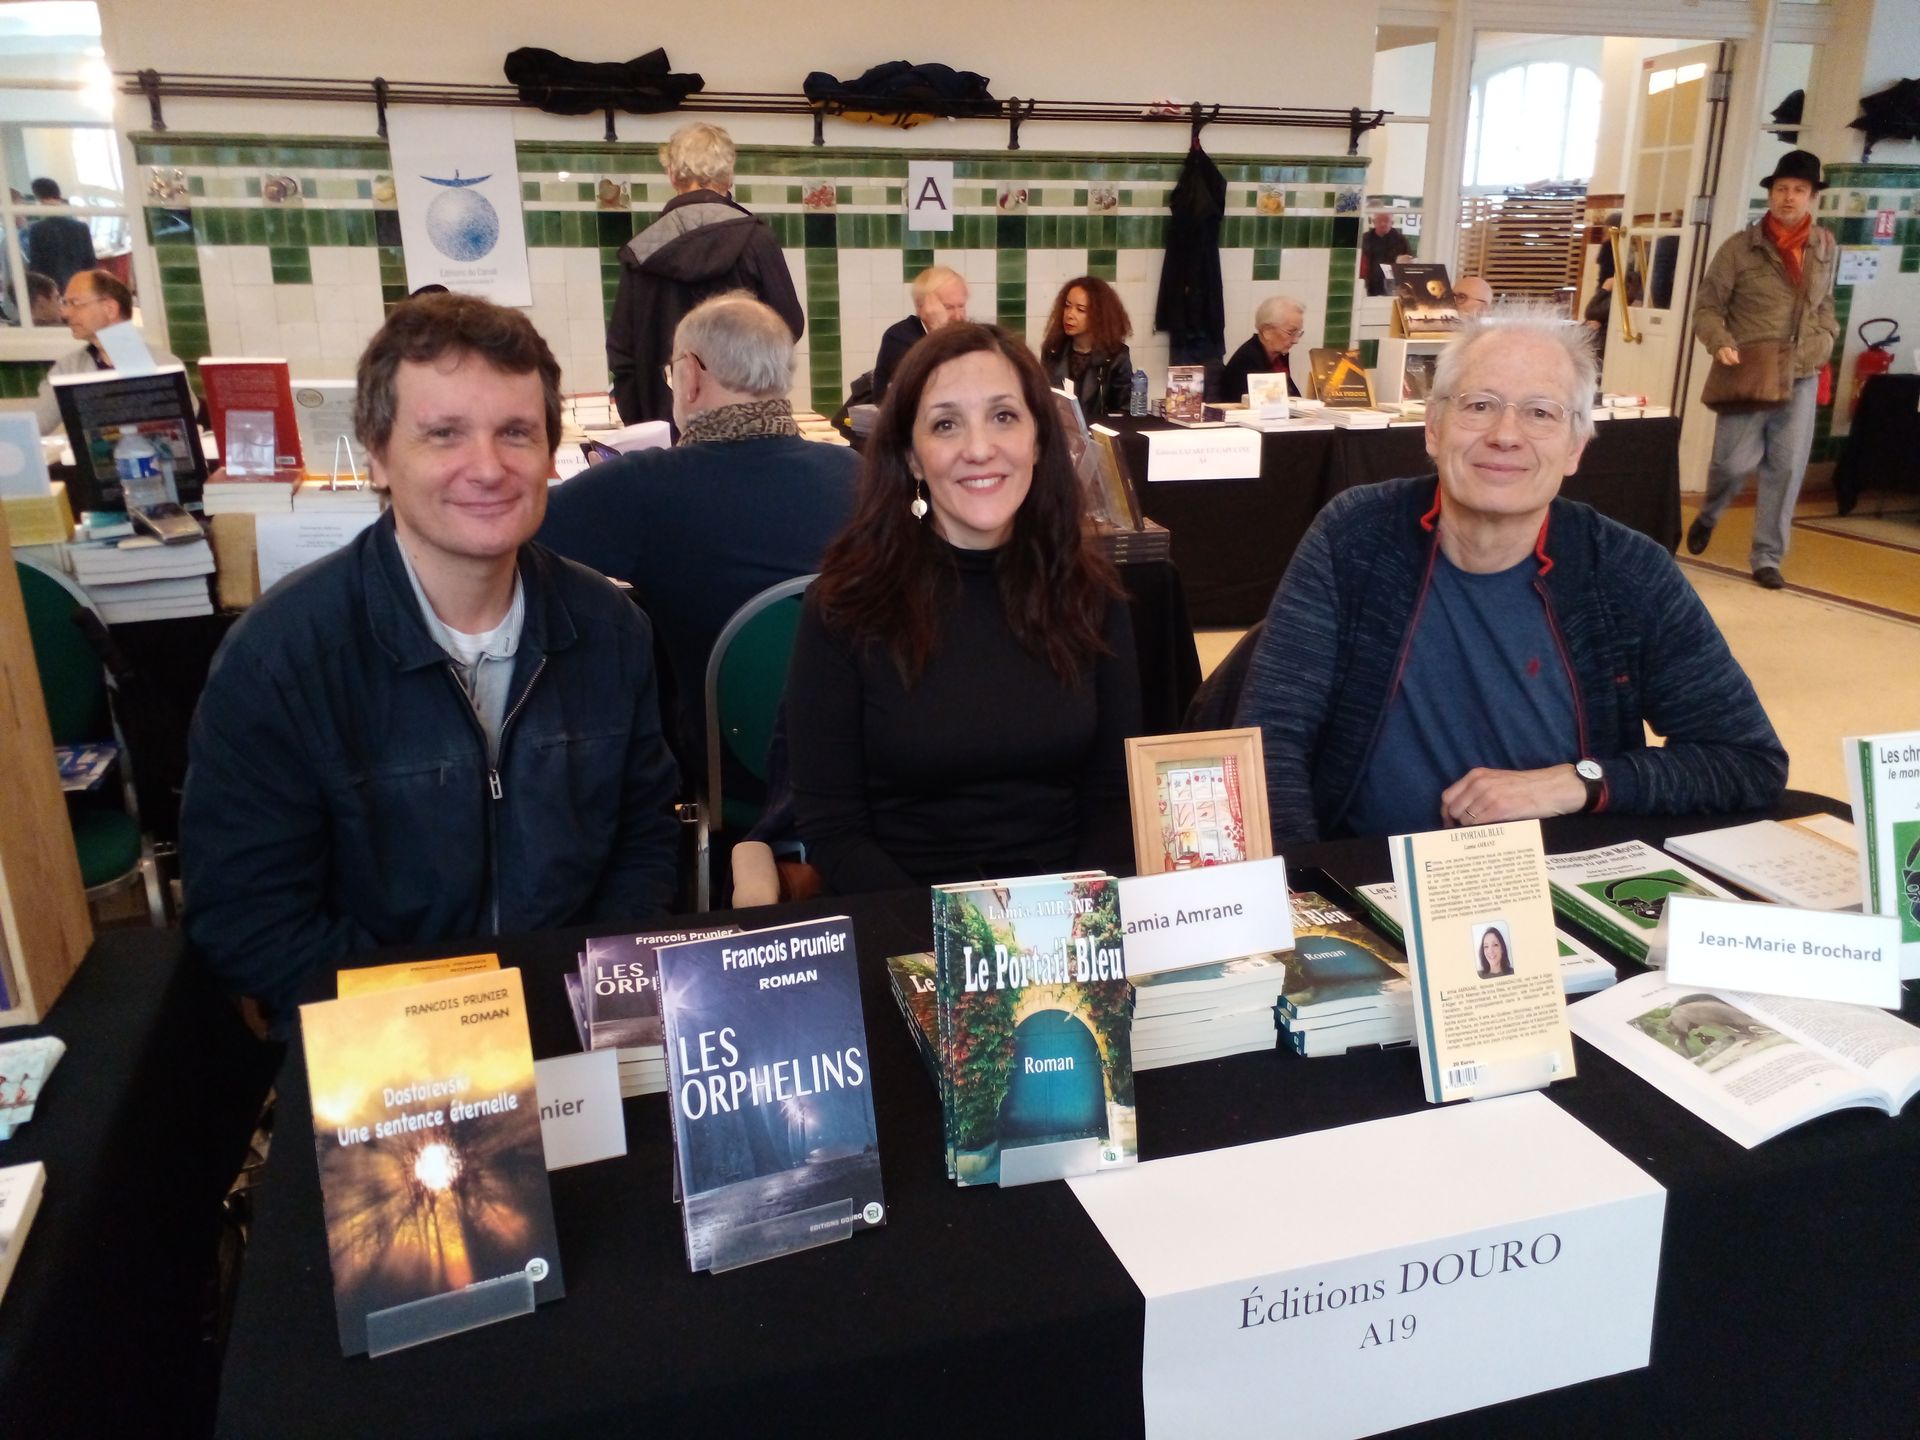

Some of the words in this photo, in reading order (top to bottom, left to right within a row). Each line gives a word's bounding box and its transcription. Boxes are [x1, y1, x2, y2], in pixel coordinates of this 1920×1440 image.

[914, 176, 948, 211] A
[1880, 747, 1899, 764] Les
[1888, 768, 1897, 780] le
[989, 904, 1030, 920] Lamia
[1036, 898, 1094, 917] AMRANE
[1122, 913, 1170, 935] amia
[1175, 903, 1244, 926] Amrane
[1305, 909, 1352, 926] Bleu
[635, 933, 687, 946] François
[722, 939, 788, 972] François
[790, 931, 847, 960] Prunier
[1698, 931, 1797, 954] Jean-Marie
[1802, 941, 1882, 962] Brochard
[963, 946, 989, 993] Le
[995, 936, 1071, 990] Portail
[1072, 935, 1125, 984] Bleu
[1304, 950, 1347, 962] Roman
[596, 962, 644, 981] LES
[759, 969, 818, 991] ROMAN
[909, 974, 936, 993] Le
[405, 998, 460, 1017] FRANCOIS
[463, 988, 509, 1006] PRUNIER
[461, 1007, 510, 1026] ROMAN
[679, 1026, 740, 1077] LES
[1024, 1056, 1074, 1075] Roman
[383, 1076, 470, 1108] Dostoevsk
[680, 1047, 865, 1121] ORPHELINS
[337, 1125, 370, 1147] Une
[375, 1109, 444, 1139] sentence
[450, 1091, 519, 1123] éternelle
[1237, 1277, 1386, 1330] Éditions
[1396, 1232, 1562, 1295] DOURO
[1358, 1314, 1417, 1350] A19
